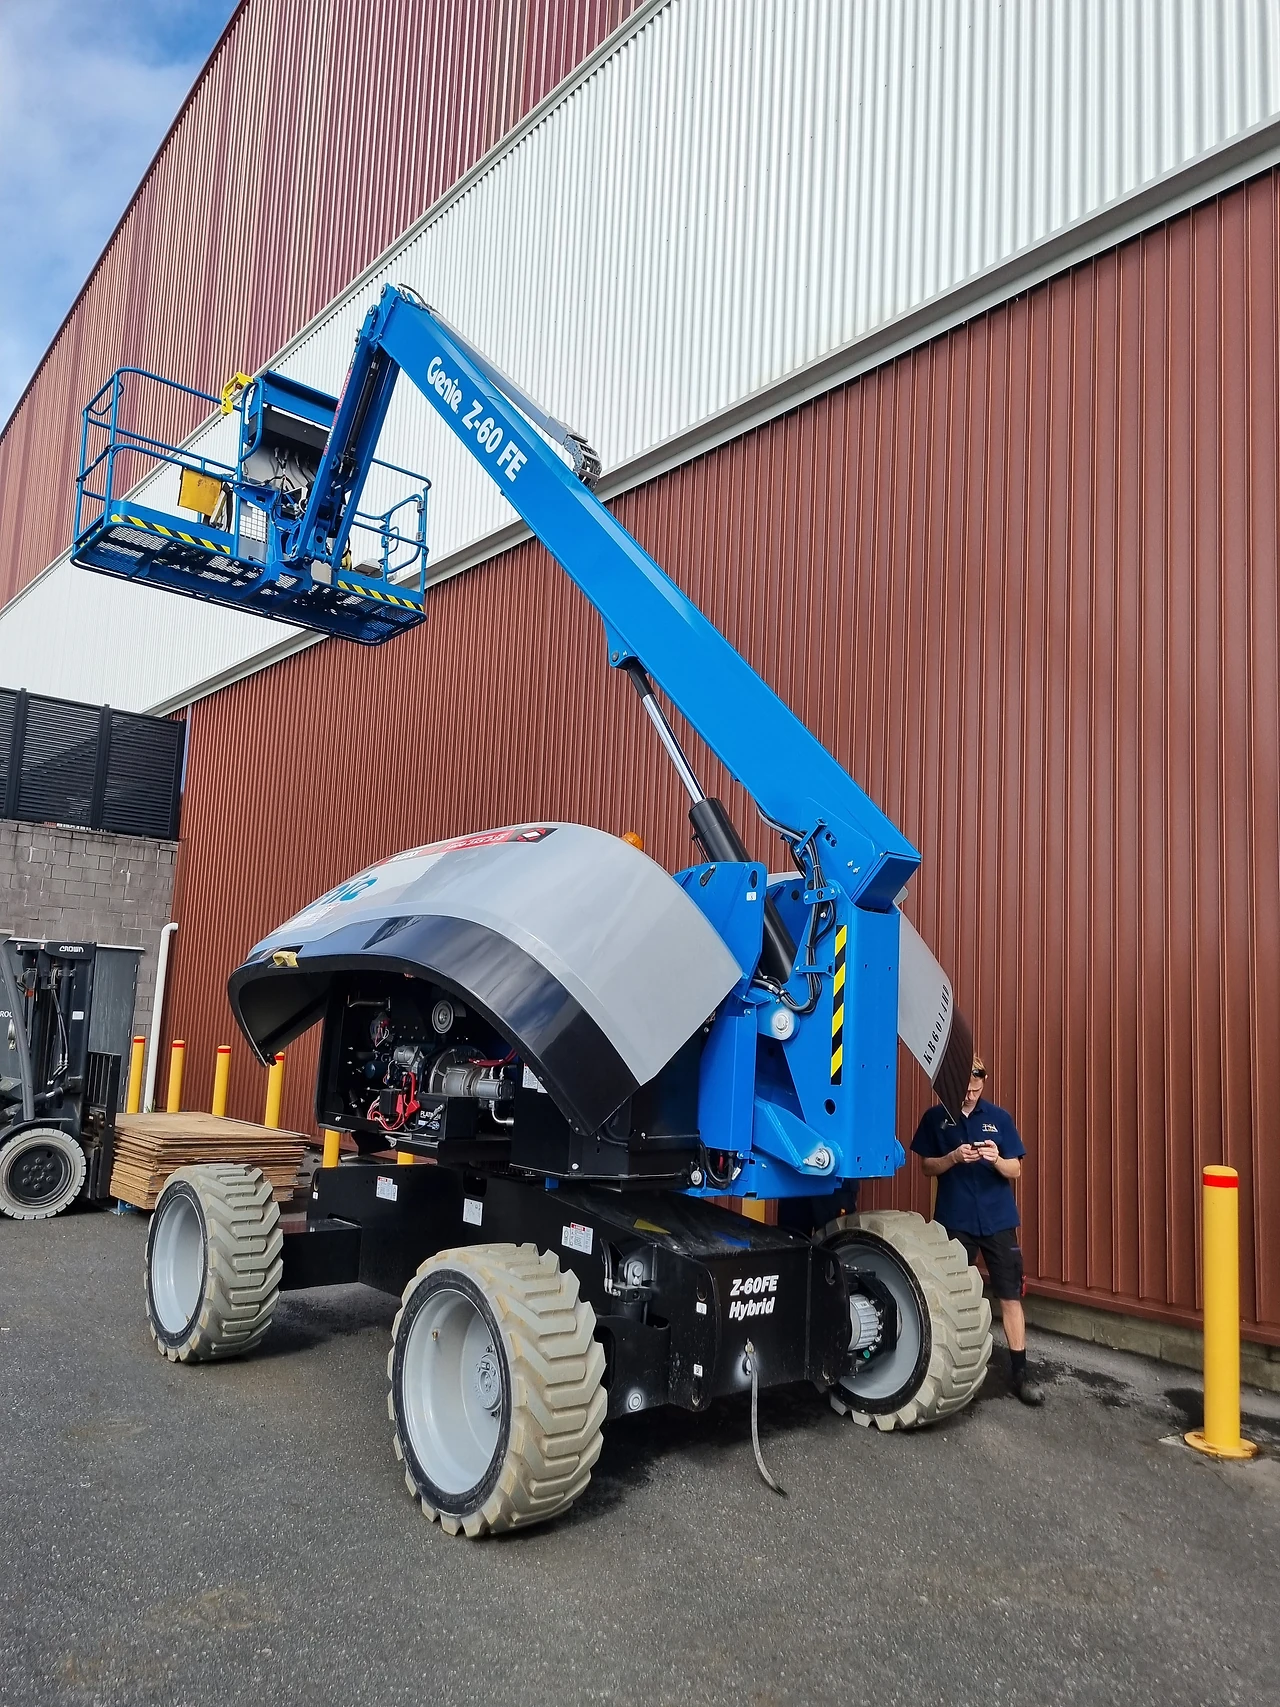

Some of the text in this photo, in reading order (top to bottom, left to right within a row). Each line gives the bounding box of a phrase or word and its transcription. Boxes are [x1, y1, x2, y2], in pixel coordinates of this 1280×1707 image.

[427, 356, 528, 483] Genie Z-60 FE
[59, 945, 84, 953] CROWN
[730, 1274, 780, 1296] Z-60FE
[729, 1296, 776, 1321] Hybrid
